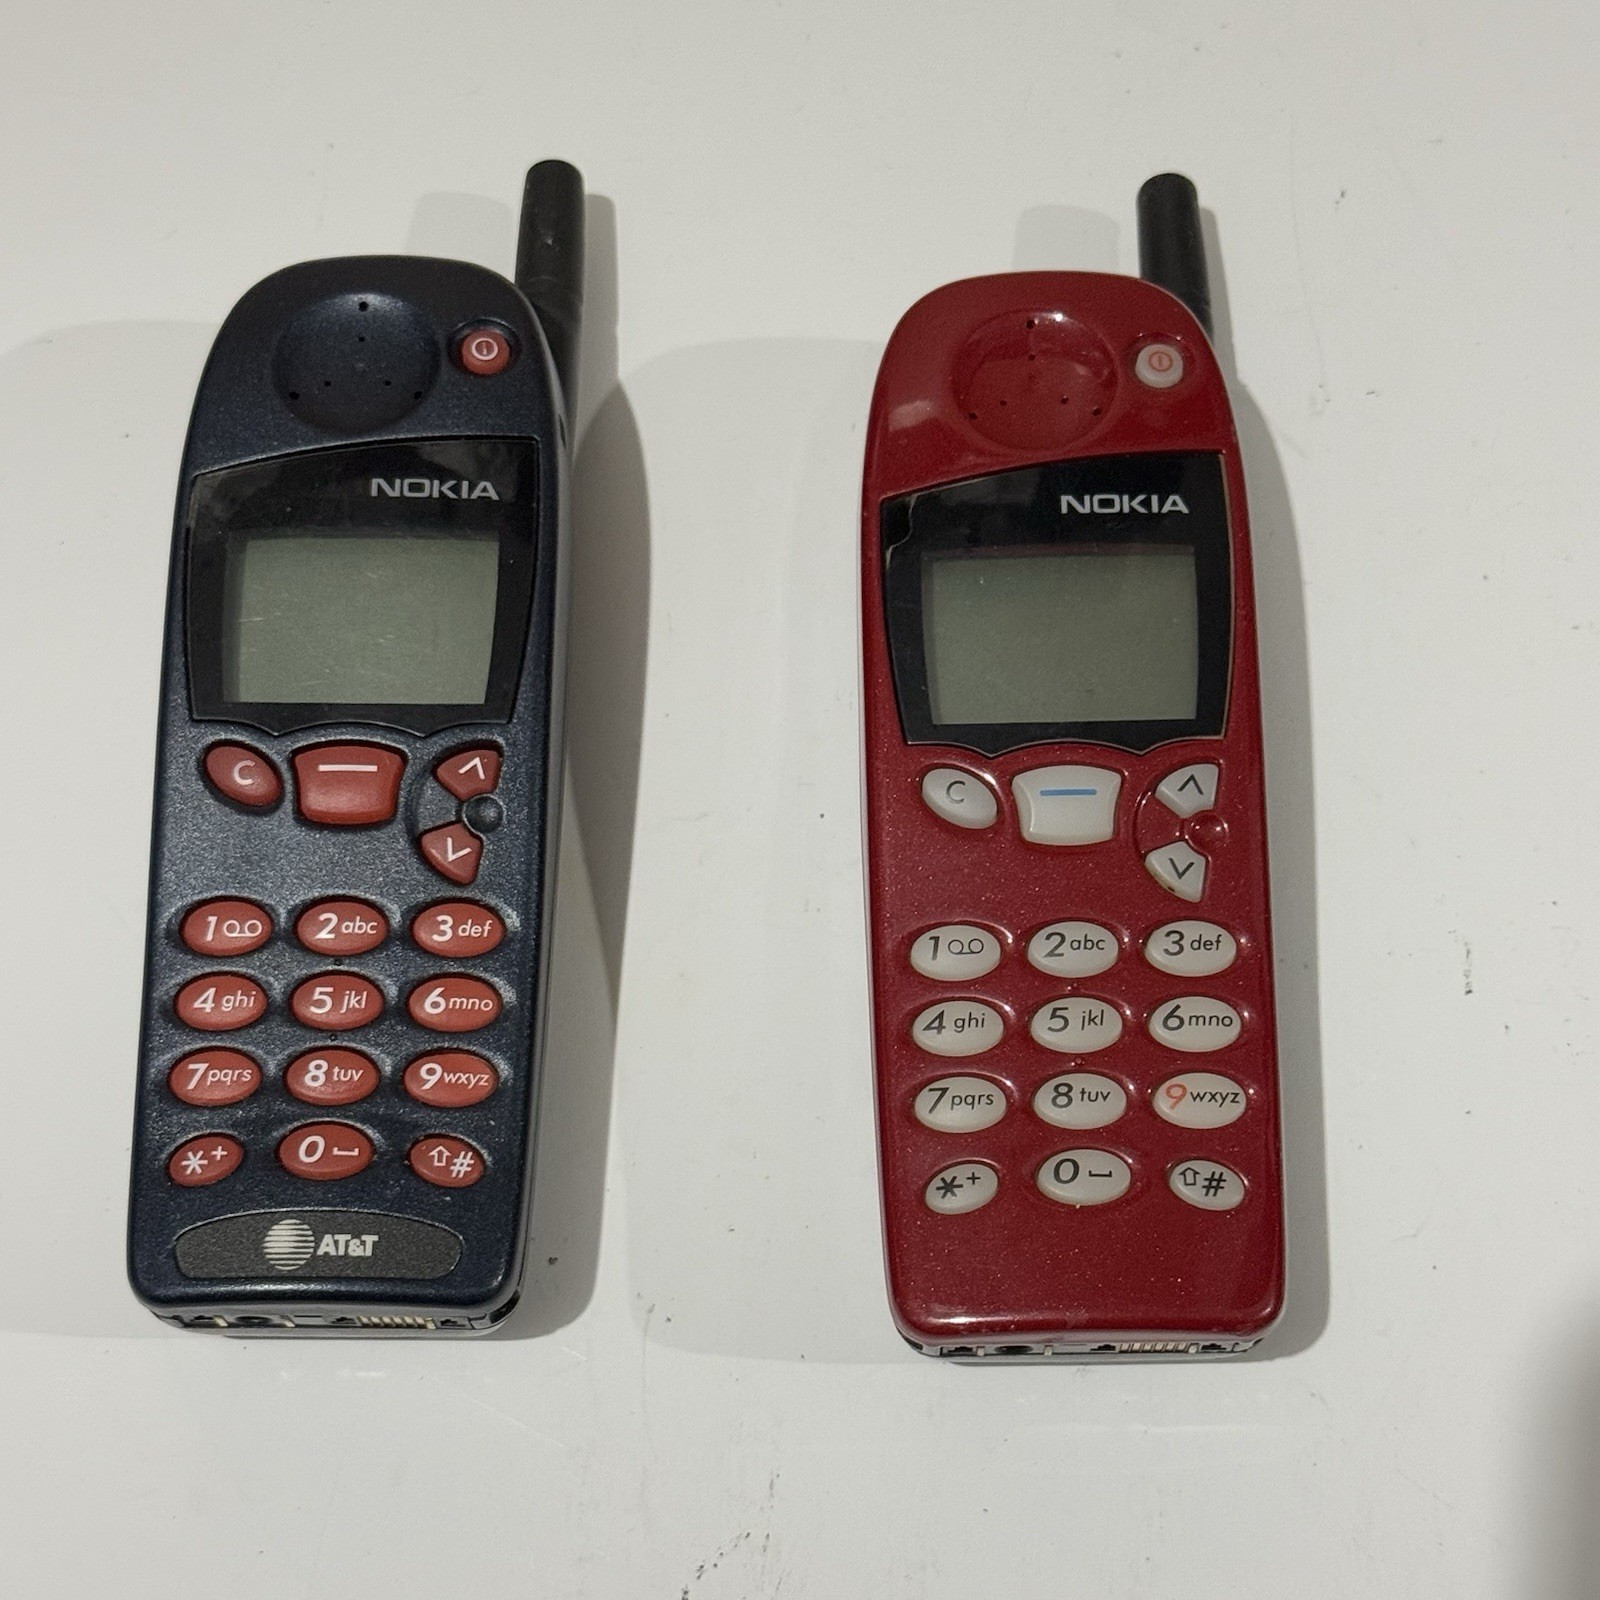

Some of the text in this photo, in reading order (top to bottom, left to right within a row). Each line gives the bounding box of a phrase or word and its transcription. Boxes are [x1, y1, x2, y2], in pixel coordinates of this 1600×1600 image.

[370, 476, 500, 501] NOKIA
[1060, 493, 1189, 515] NOKIA
[233, 760, 256, 786] C
[946, 781, 966, 804] C
[317, 1234, 379, 1257] AT&T
